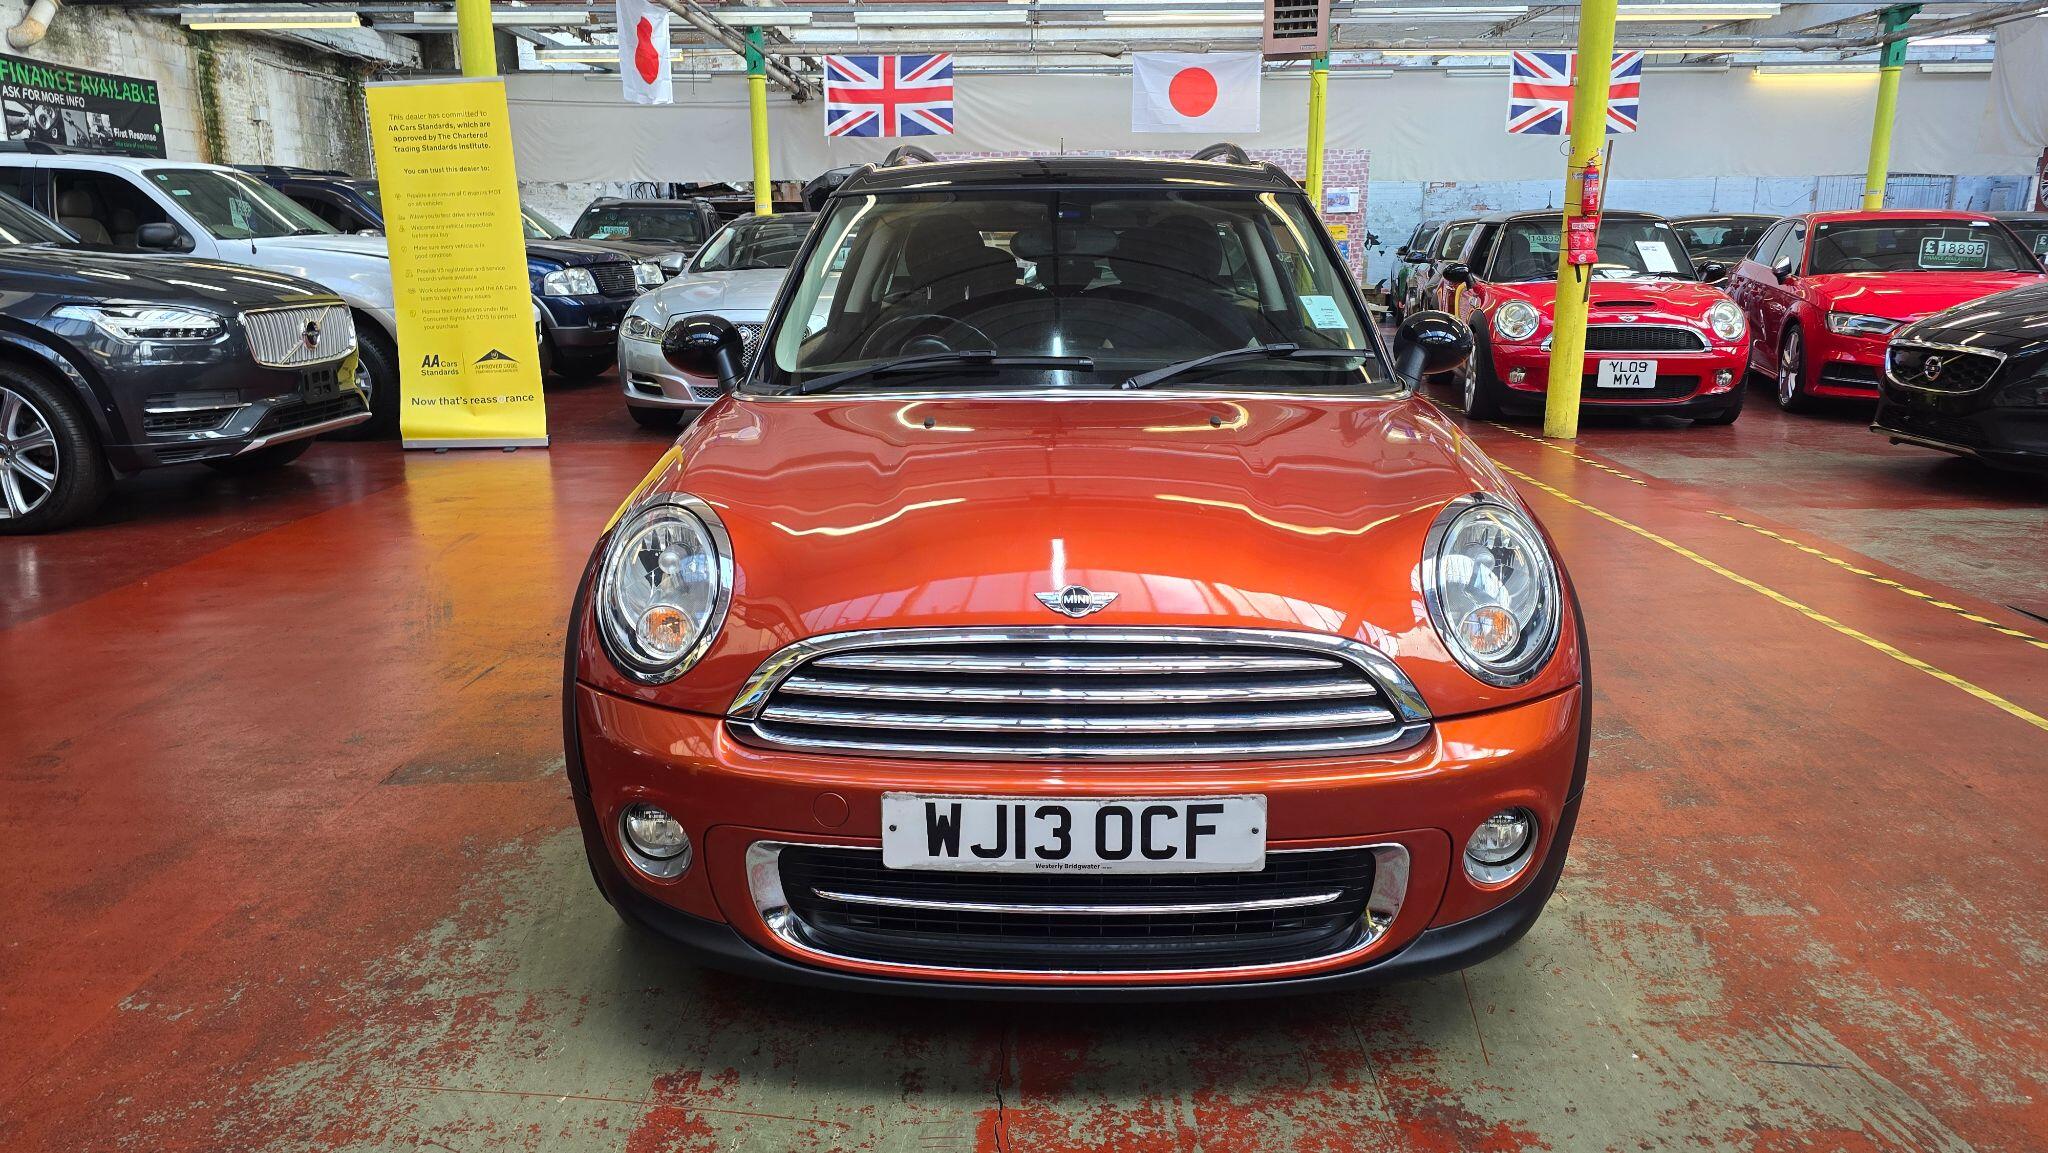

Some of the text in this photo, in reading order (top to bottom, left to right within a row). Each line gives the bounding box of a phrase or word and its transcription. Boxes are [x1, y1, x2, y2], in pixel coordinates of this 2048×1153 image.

[0, 60, 156, 104] FINANCE AVAILABLE
[3, 85, 85, 108] ASK FOR MORE INFO
[128, 130, 156, 141] Response
[394, 134, 426, 142] approved
[1941, 244, 1983, 255] 18895
[422, 355, 439, 367] AA
[1611, 362, 1647, 372] YL09
[1614, 374, 1639, 385] MYA
[411, 397, 436, 405] Now
[439, 397, 467, 405] that's
[1064, 595, 1091, 604] MINI
[925, 802, 1224, 860] WJ13 OCF
